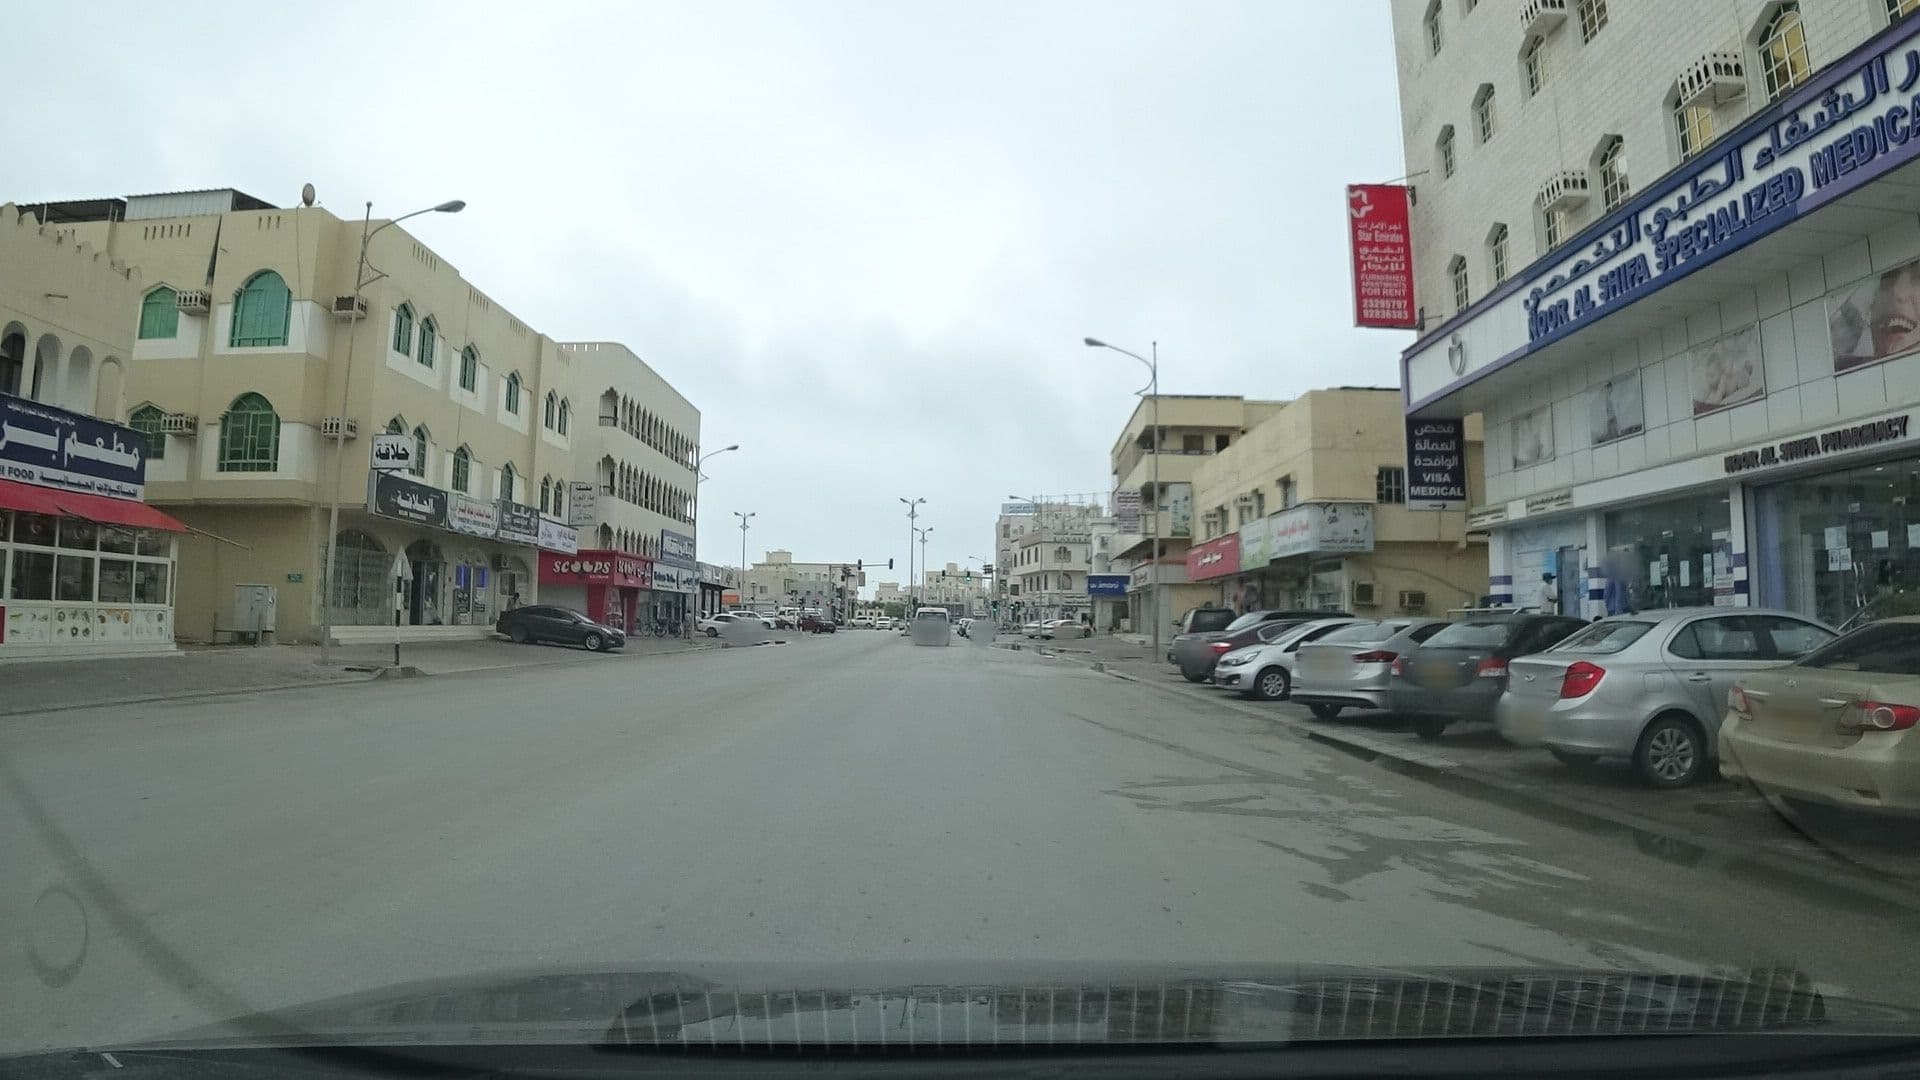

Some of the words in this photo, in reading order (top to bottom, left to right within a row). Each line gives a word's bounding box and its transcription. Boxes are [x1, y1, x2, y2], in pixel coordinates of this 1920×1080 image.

[1753, 55, 1889, 169] الشفاء
[1644, 145, 1744, 244] الطبي
[1357, 230, 1372, 241] Star
[1523, 210, 1641, 311] التخصصي
[1529, 298, 1570, 341] NOOR
[1574, 284, 1596, 317] AL
[1598, 253, 1651, 300] SHIFA
[1655, 166, 1804, 271] SPECIALIZED
[1361, 288, 1380, 296] FOR
[1382, 288, 1407, 297] RENT
[1414, 423, 1455, 436] فحص
[1821, 415, 1909, 453] PHARMACY
[63, 431, 139, 471] مطعم
[375, 443, 410, 460] حلاقة
[1415, 439, 1456, 451] العمالة
[1414, 455, 1459, 470] الوافدة
[8, 466, 34, 480] FOOD
[1422, 472, 1451, 482] VISA
[1410, 486, 1465, 497] MEDICAL
